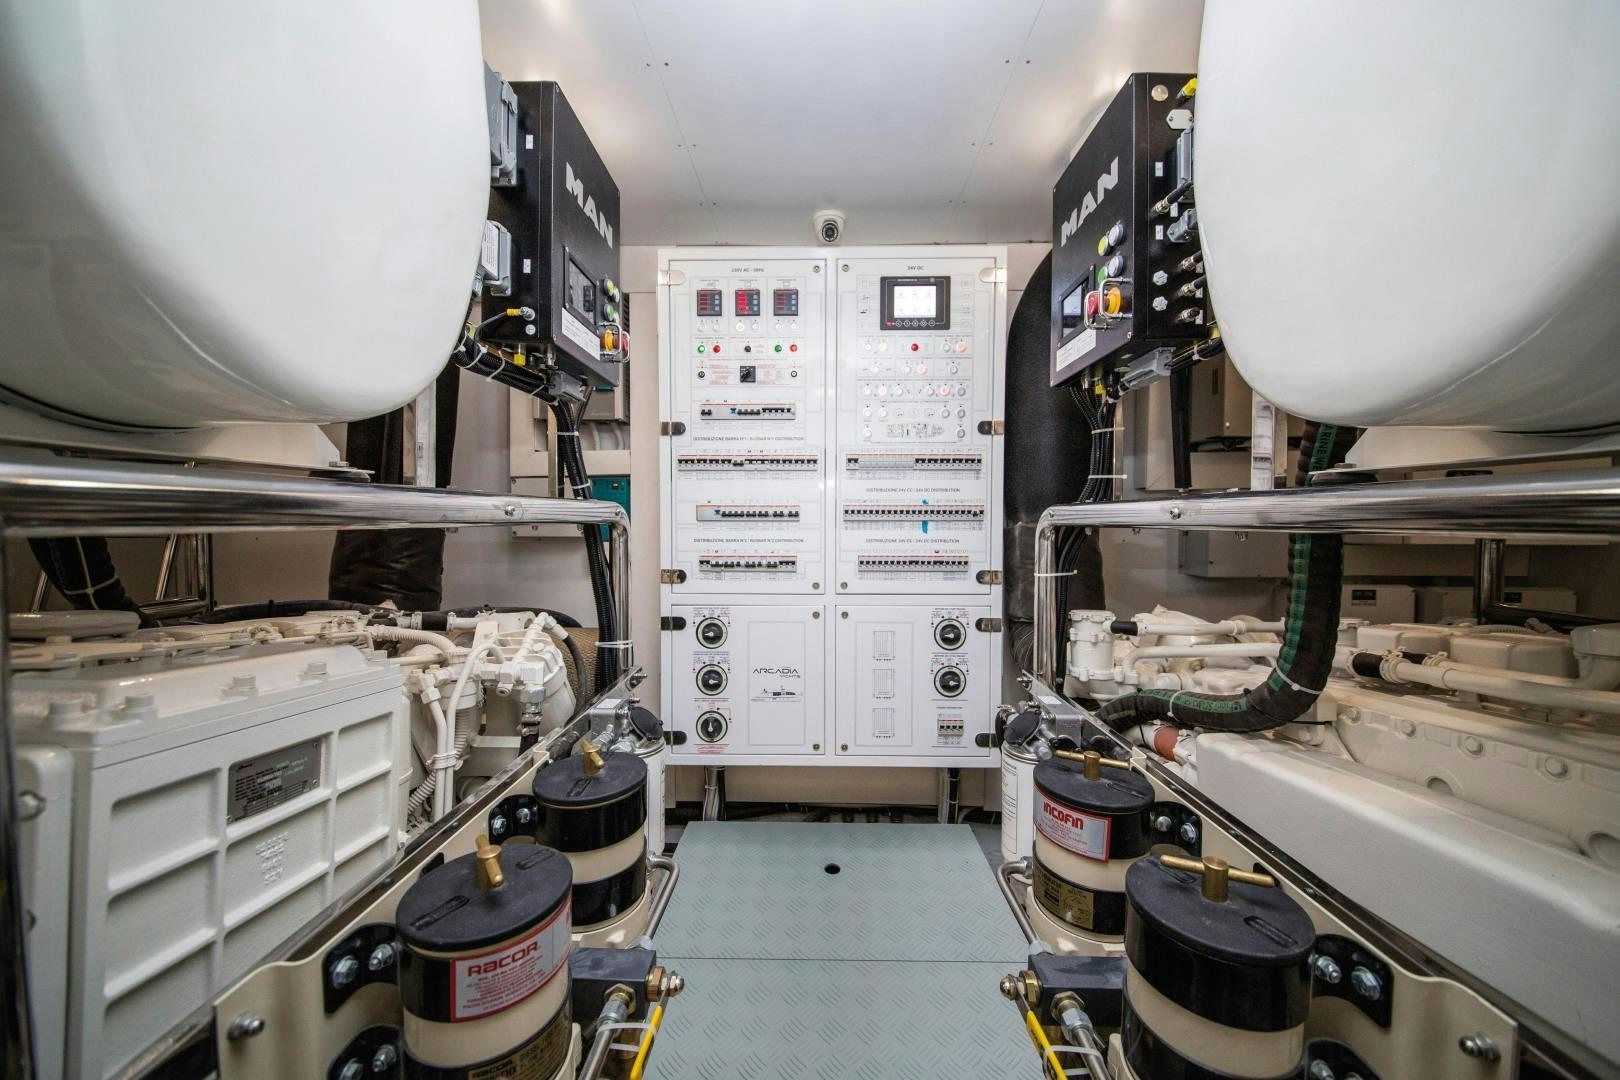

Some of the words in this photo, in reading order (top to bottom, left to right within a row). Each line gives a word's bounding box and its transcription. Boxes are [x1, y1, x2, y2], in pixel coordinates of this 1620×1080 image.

[566, 161, 613, 249] MAN
[1060, 156, 1119, 247] MAN
[1316, 422, 1334, 455] ARINE
[467, 940, 539, 977] RACOR
